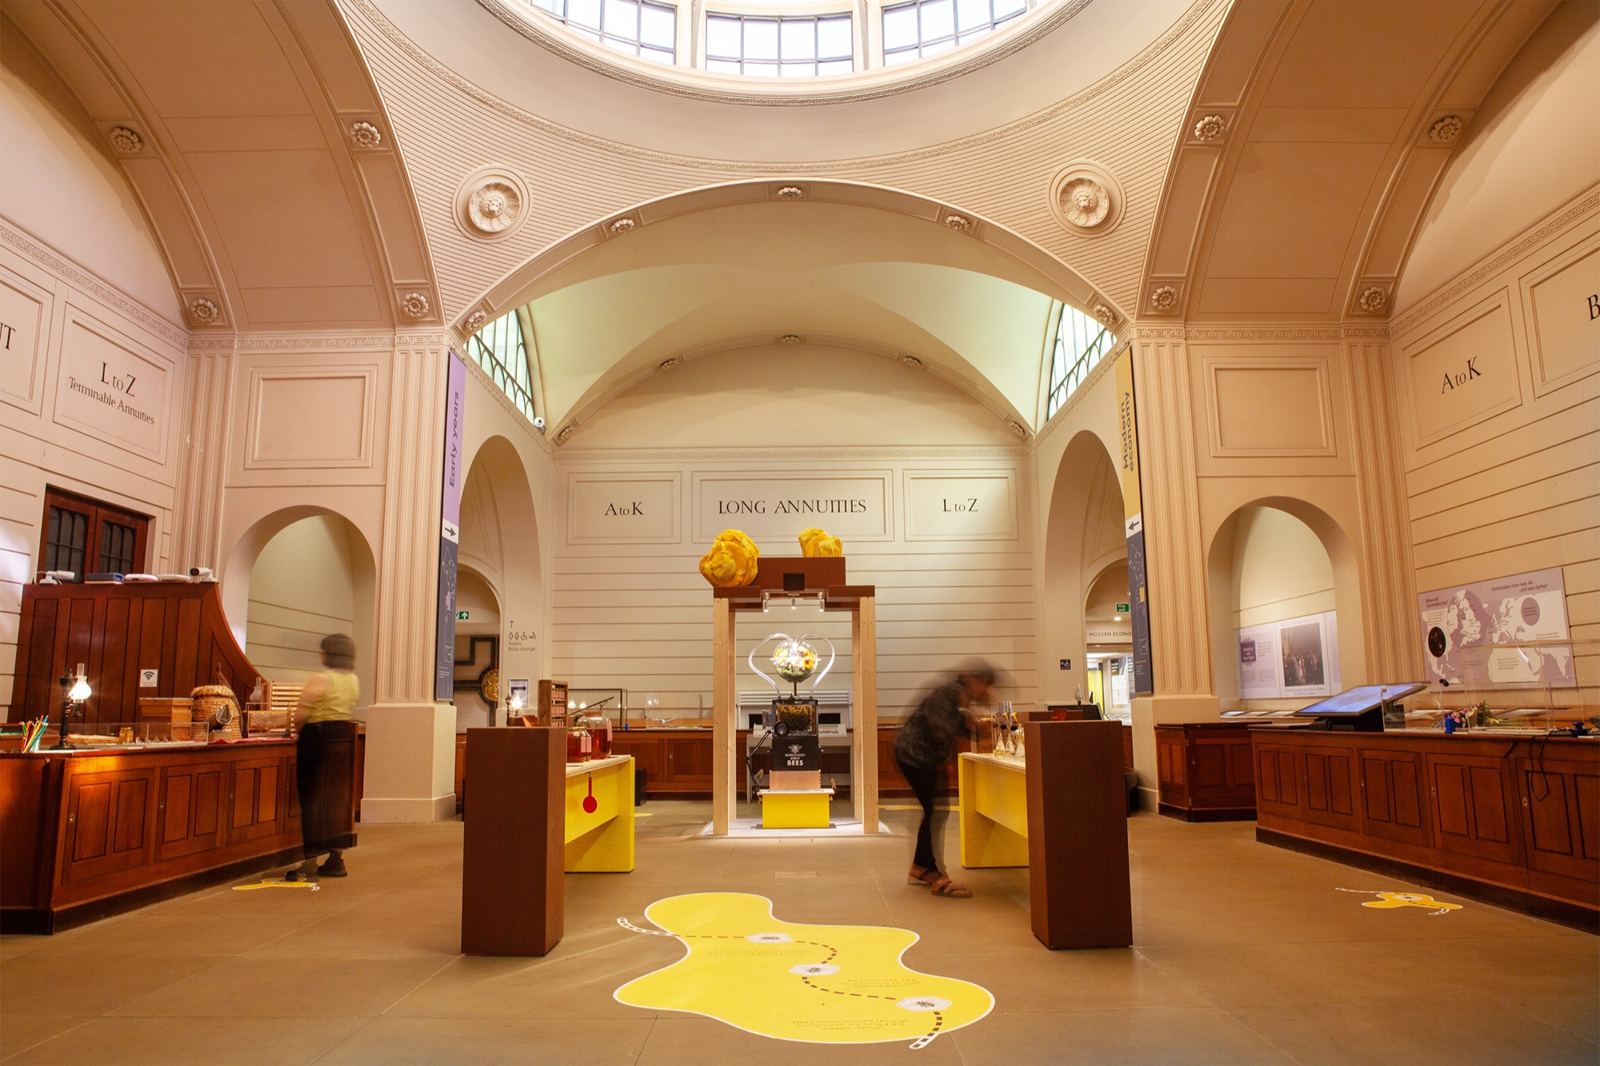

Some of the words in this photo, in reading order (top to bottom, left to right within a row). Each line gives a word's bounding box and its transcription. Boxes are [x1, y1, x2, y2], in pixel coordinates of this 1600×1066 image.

[100, 361, 110, 385] L
[112, 374, 124, 392] to
[125, 373, 137, 397] Z
[1441, 372, 1455, 394] A
[1455, 372, 1467, 387] to
[1466, 356, 1482, 380] K
[69, 376, 116, 408] Terminable
[117, 399, 155, 425] Annuities
[1124, 391, 1133, 472] economy
[449, 443, 458, 488] Early
[604, 502, 617, 516] A
[619, 507, 630, 516] to
[632, 502, 644, 516] K
[718, 500, 766, 515] LONG
[774, 499, 867, 514] ANNUITIES
[943, 498, 951, 513] L
[954, 503, 966, 513] to
[967, 498, 979, 513] Z
